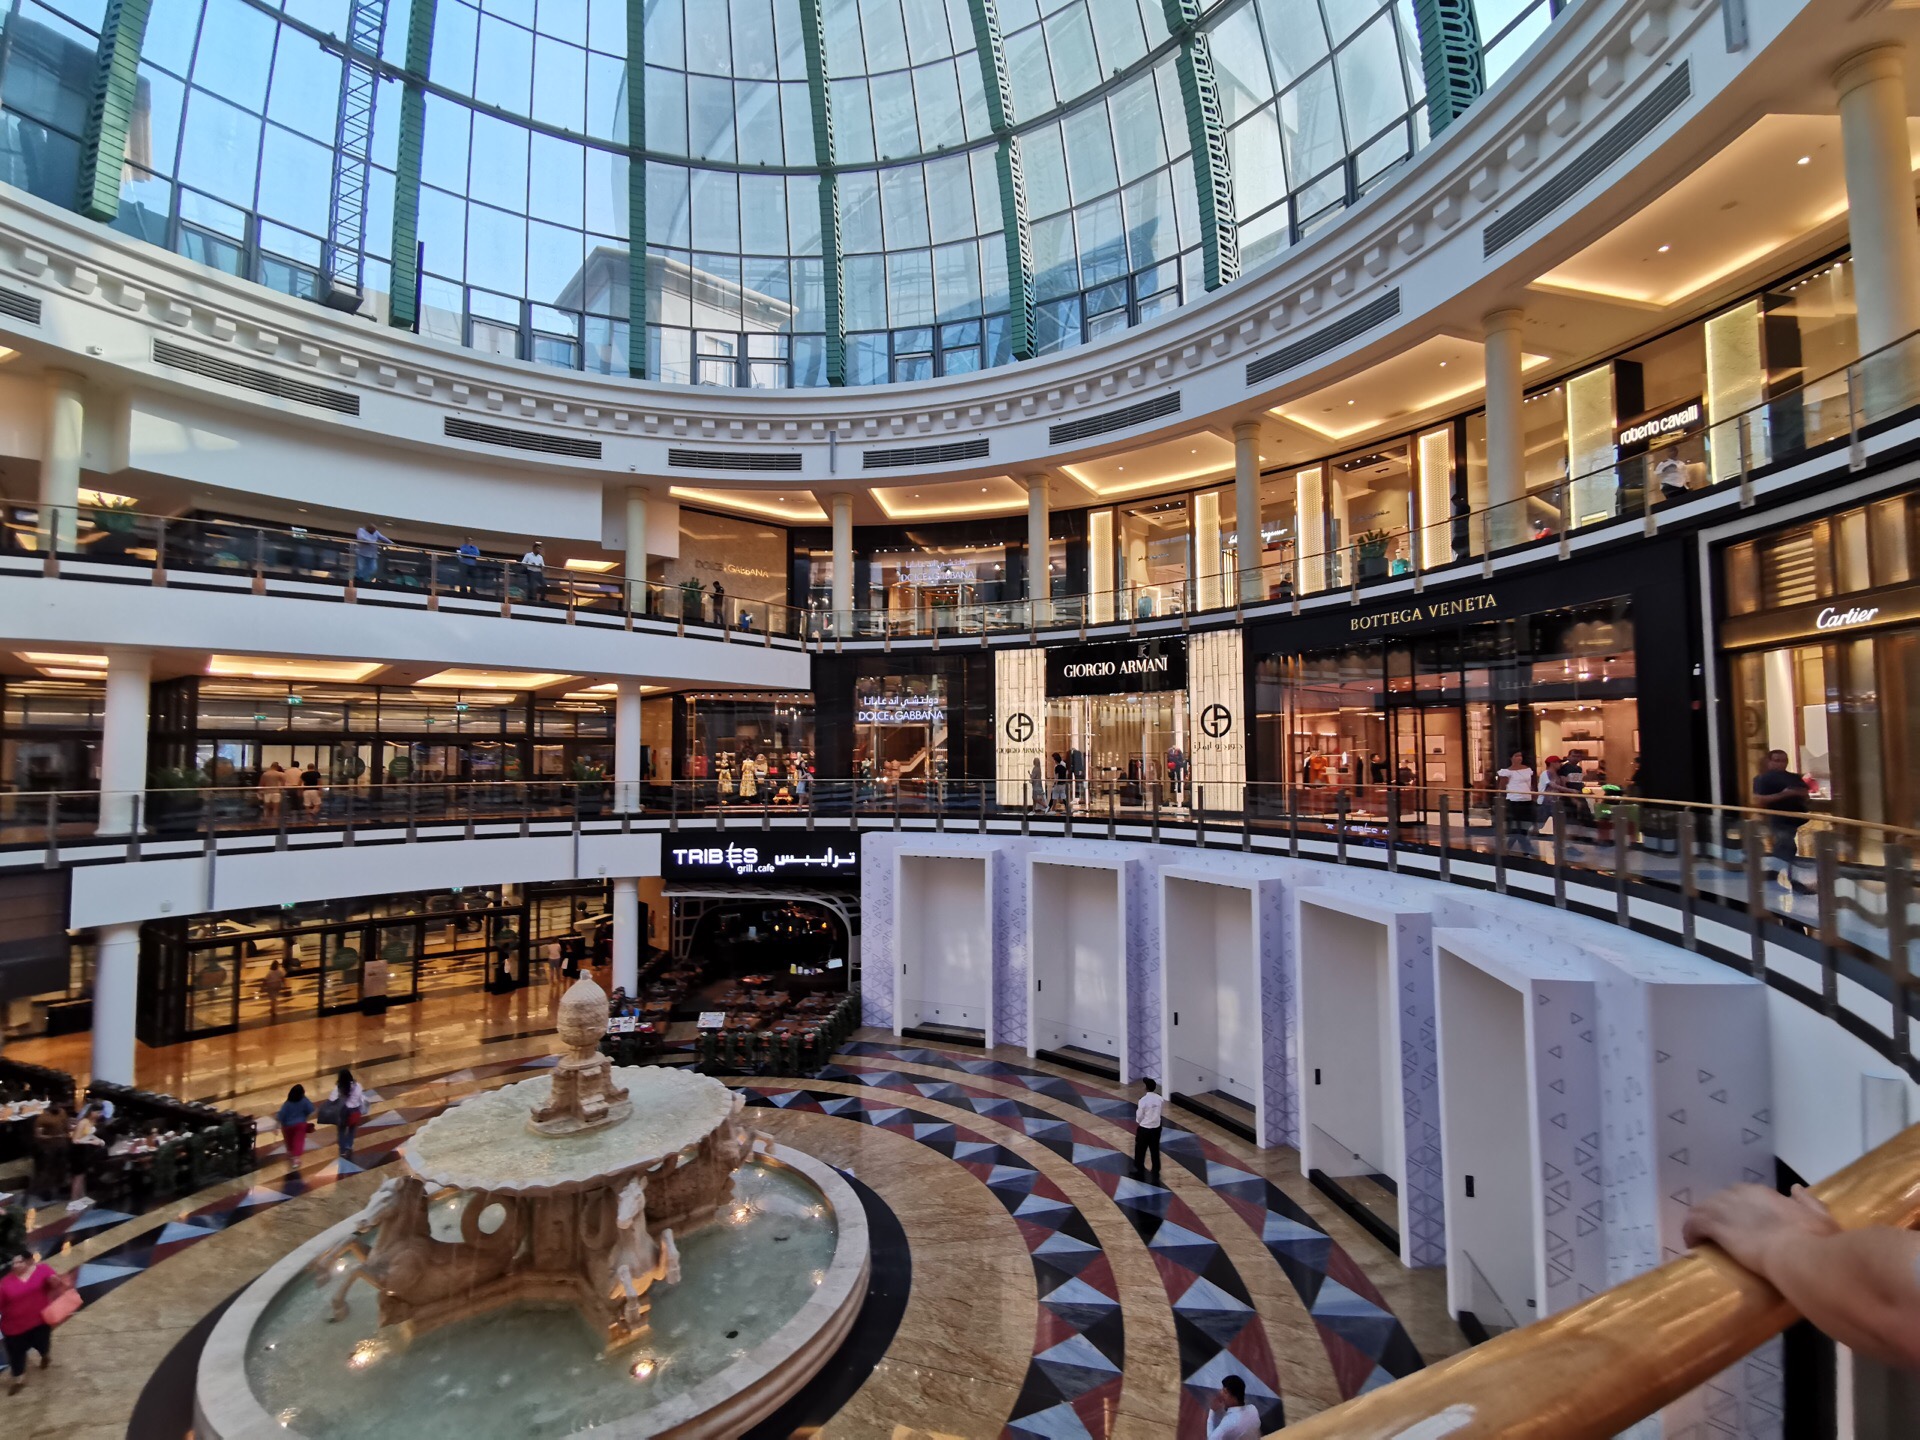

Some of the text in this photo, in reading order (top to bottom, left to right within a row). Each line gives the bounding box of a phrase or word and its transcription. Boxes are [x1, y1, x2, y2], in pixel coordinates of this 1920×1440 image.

[1620, 404, 1698, 445] roberto cavalli
[1350, 593, 1498, 631] BOTTEGA VENETA
[1816, 607, 1879, 629] Cartier
[1064, 657, 1168, 678] GIORGIO ARMANI
[672, 842, 759, 868] TRIBES
[774, 847, 856, 867] ترايبس
